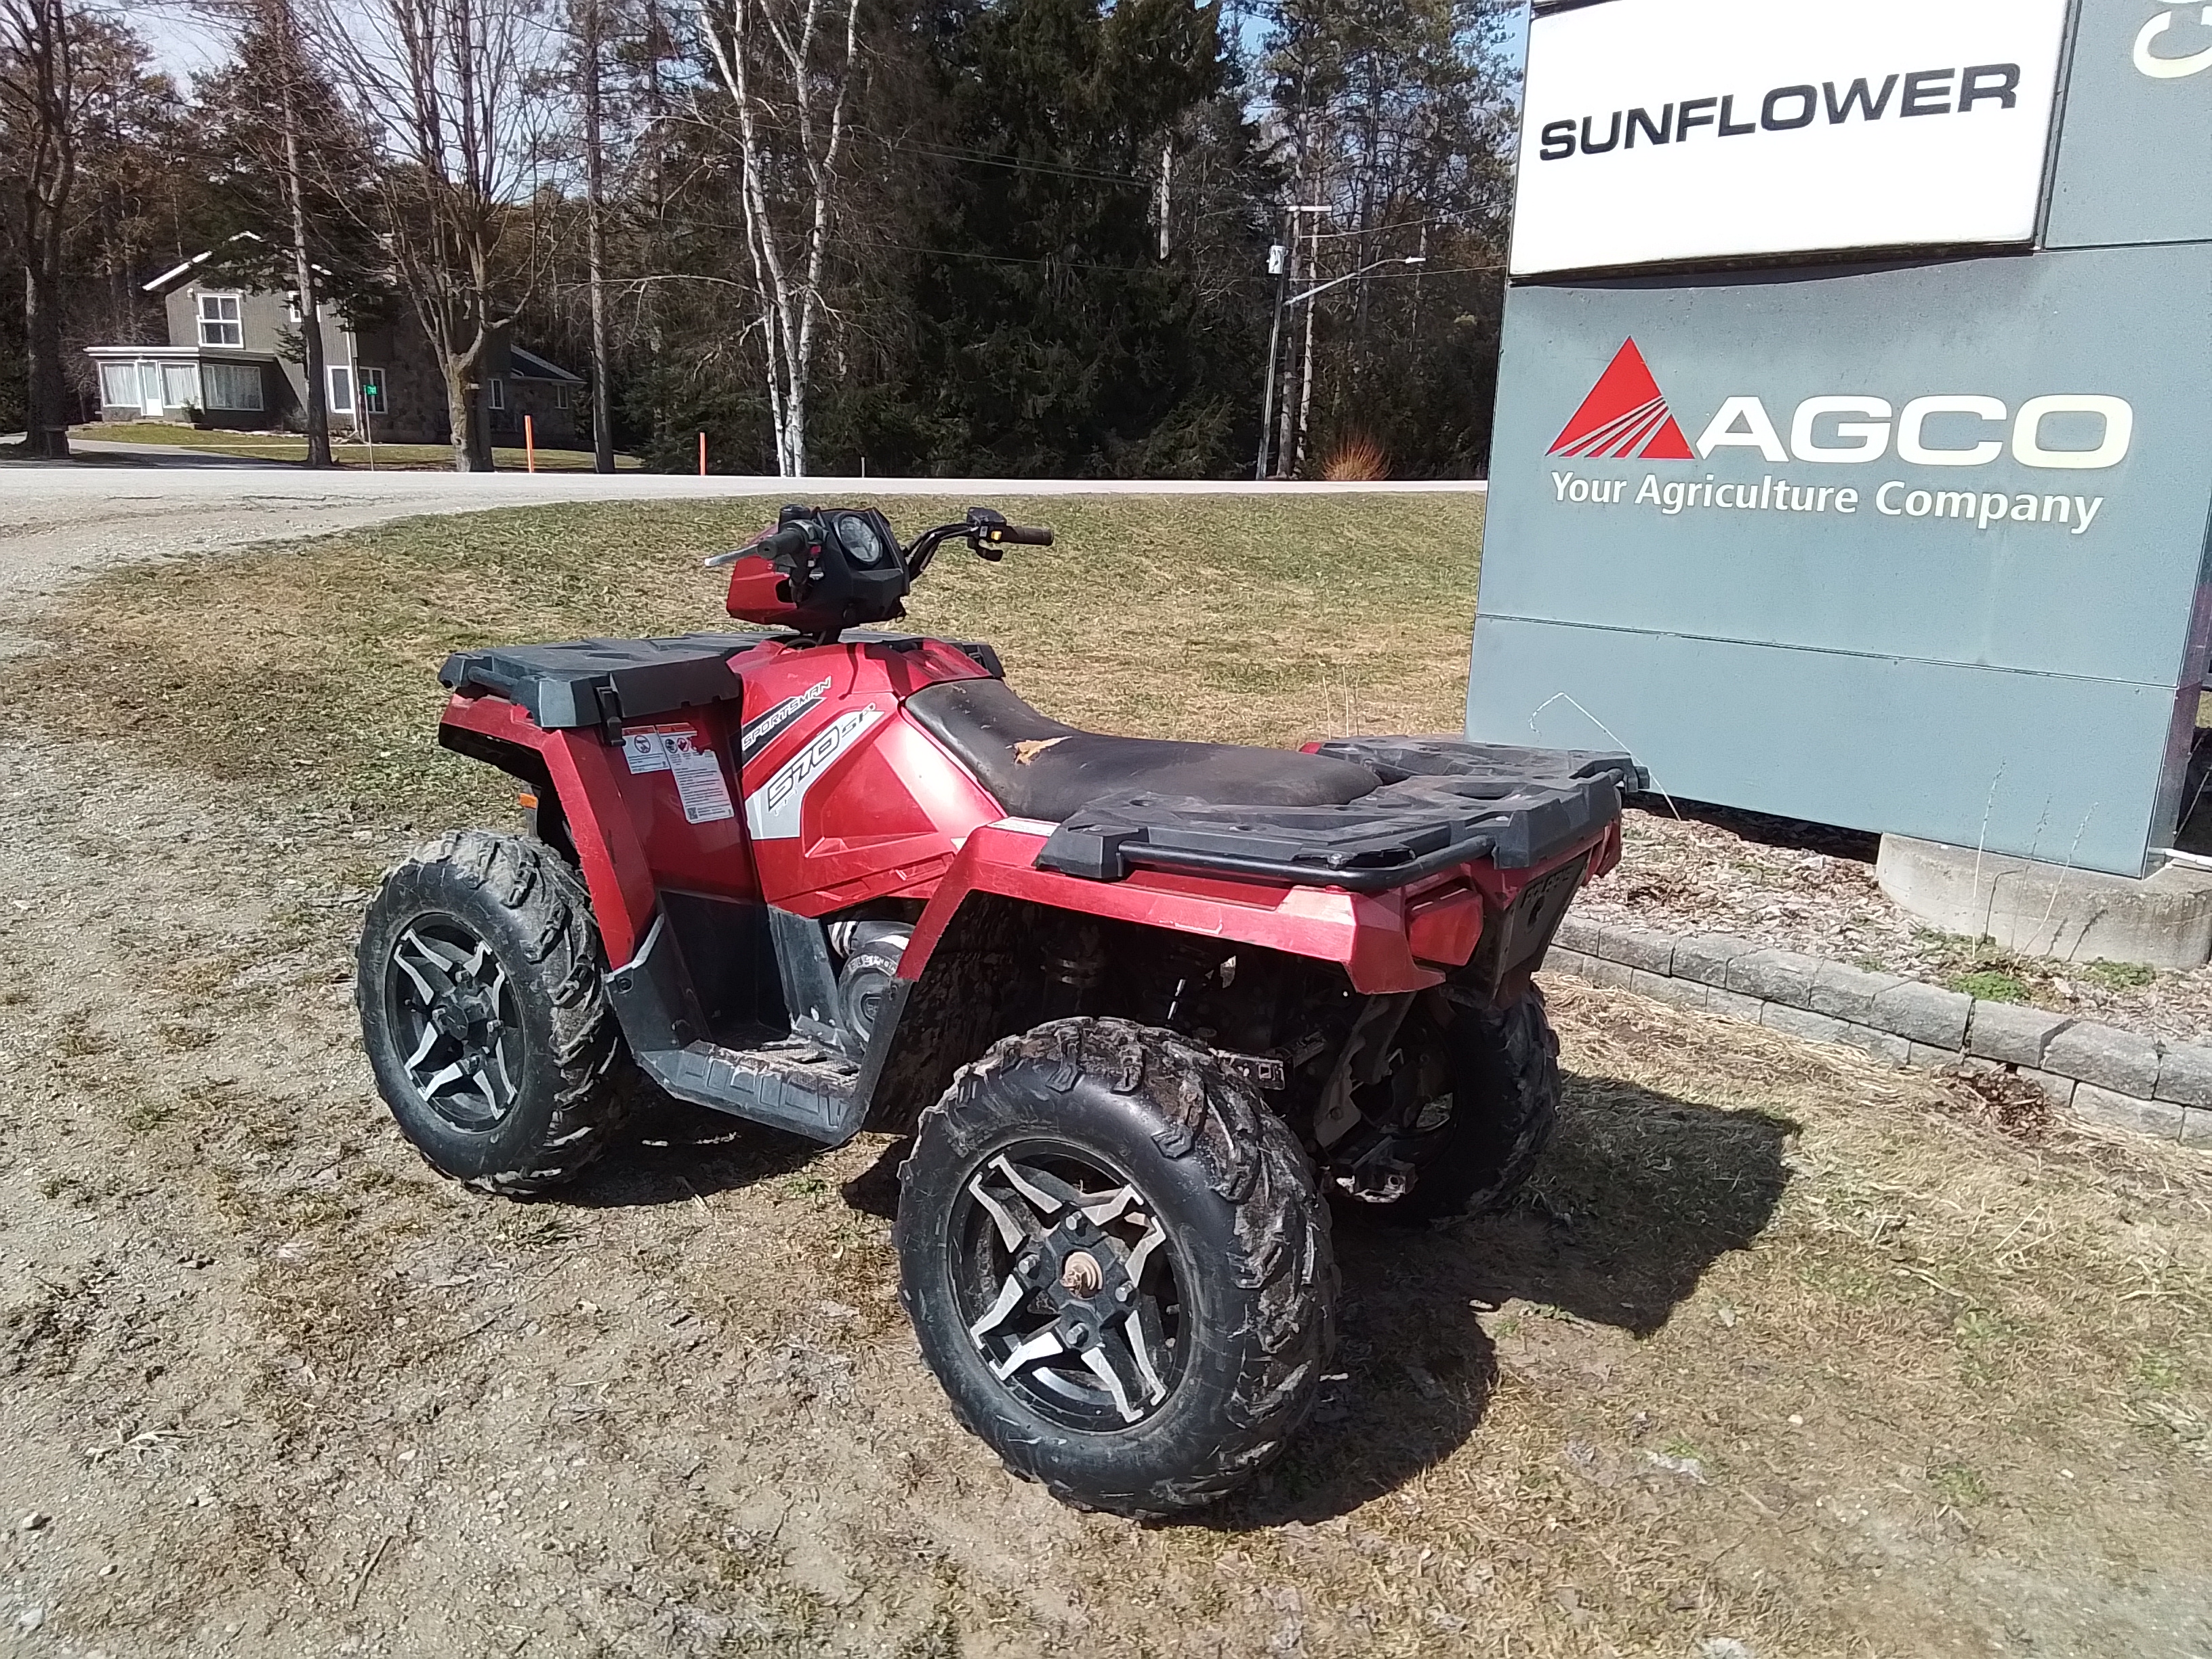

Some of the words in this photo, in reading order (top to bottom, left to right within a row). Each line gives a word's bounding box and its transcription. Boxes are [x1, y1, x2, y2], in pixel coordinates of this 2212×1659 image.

[1540, 63, 2021, 161] SUNFLOWER
[1696, 394, 2133, 470] AGCO
[1551, 472, 1626, 504] Your
[1635, 474, 1859, 514] Agriculture
[1875, 480, 2104, 535] Company
[742, 676, 831, 751] SPORTSMAN
